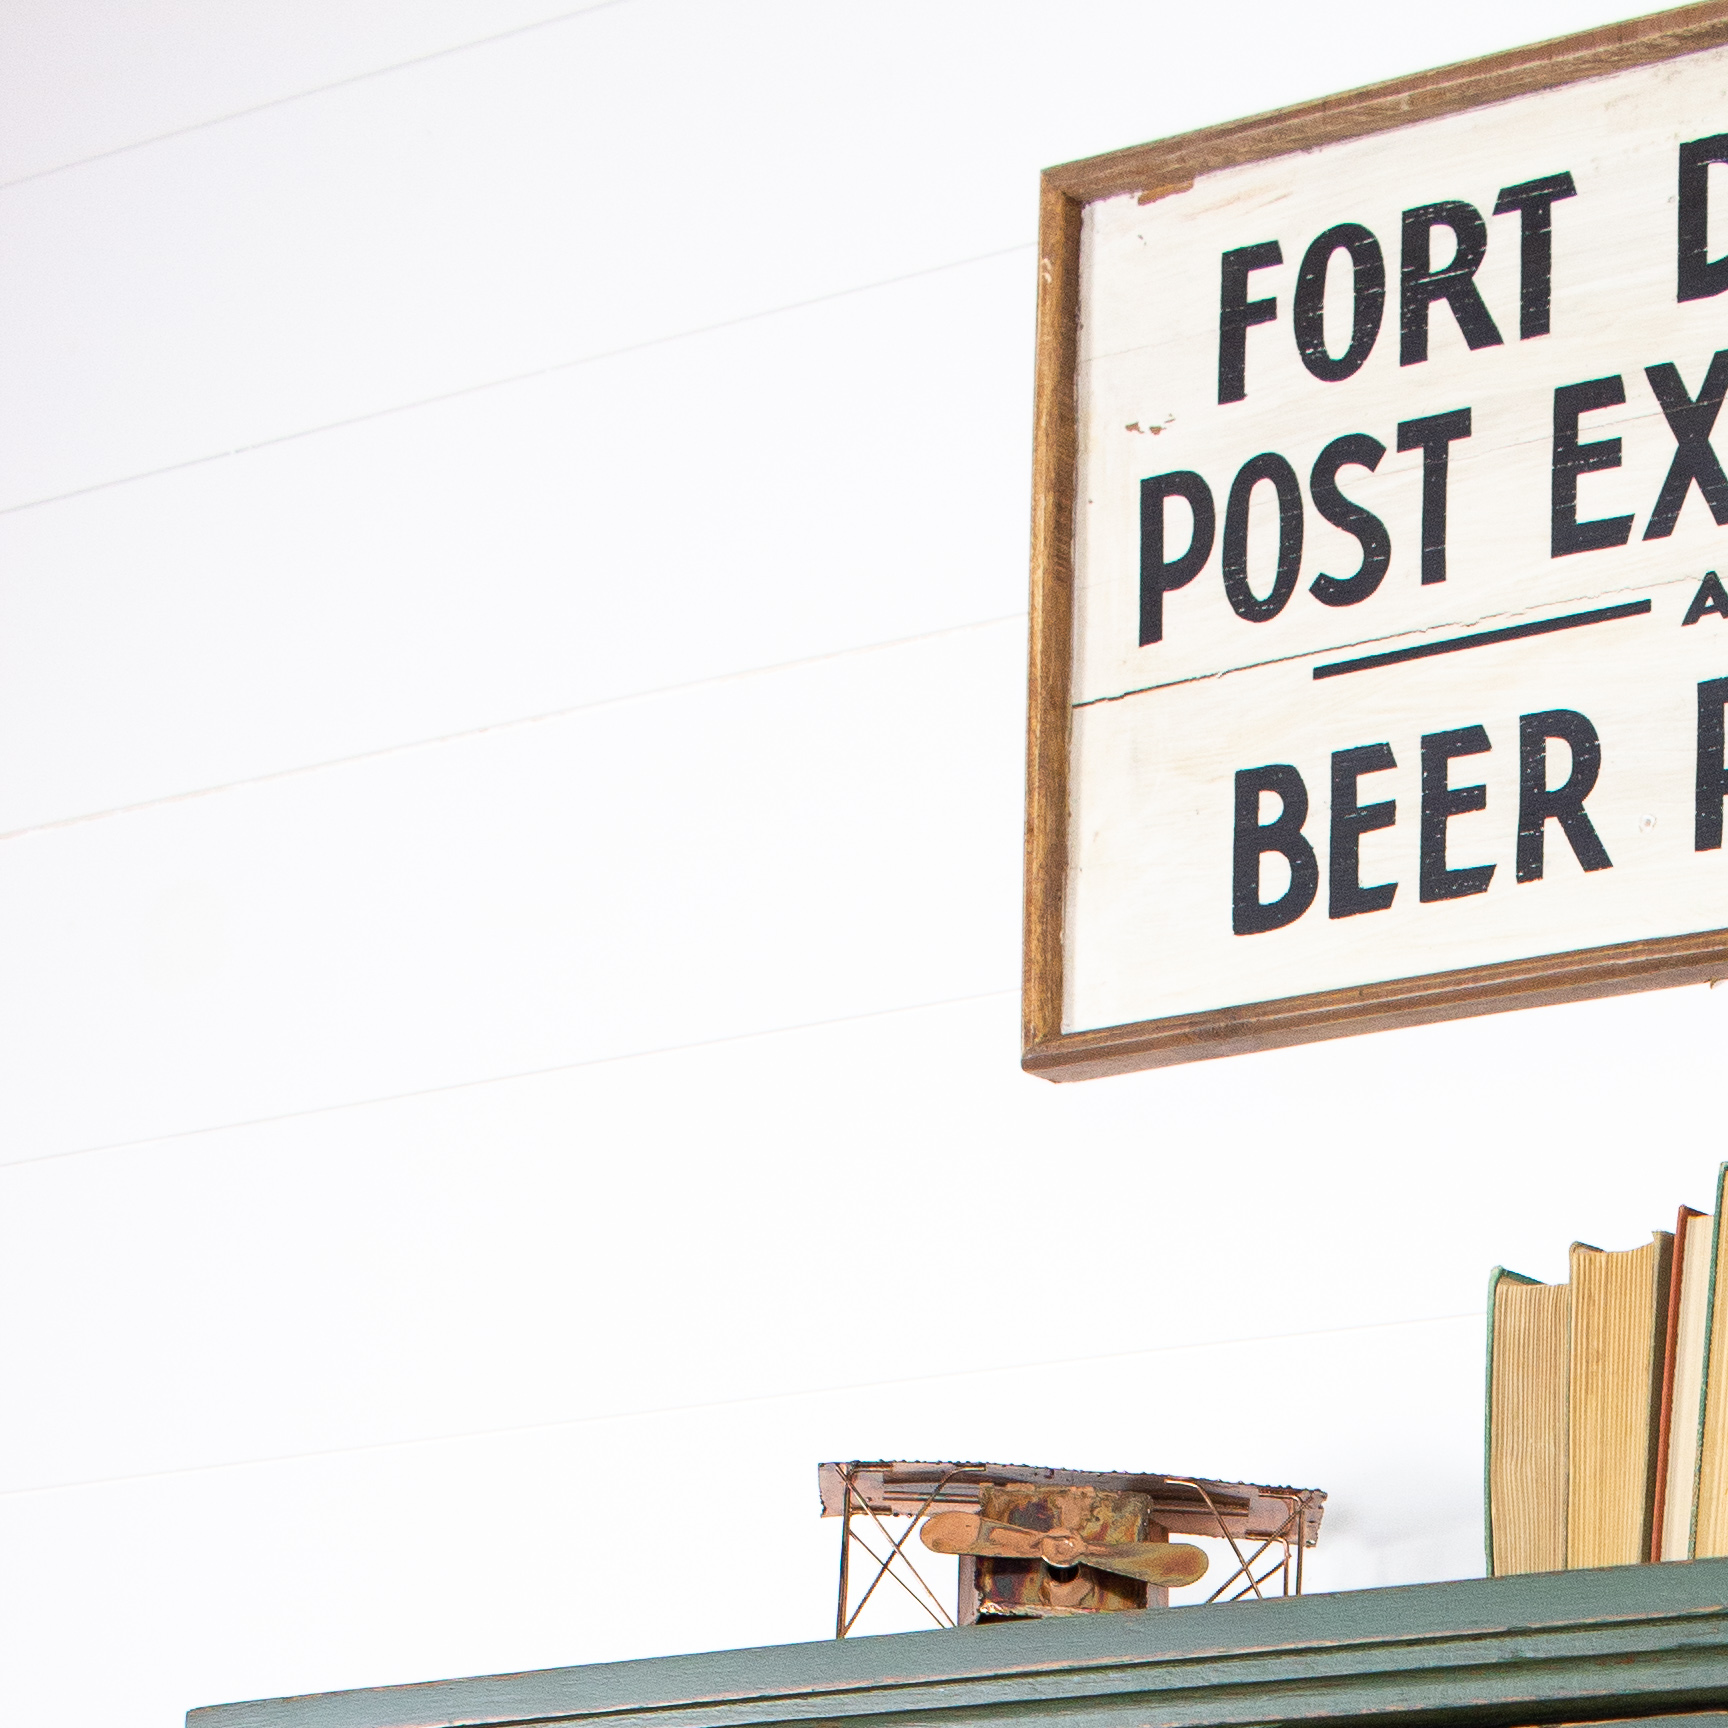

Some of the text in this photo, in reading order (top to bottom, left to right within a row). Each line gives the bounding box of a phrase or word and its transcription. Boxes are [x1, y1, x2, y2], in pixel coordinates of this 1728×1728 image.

[1218, 171, 1577, 404] FORT
[1139, 407, 1472, 647] POST
[1232, 709, 1613, 936] BEER
